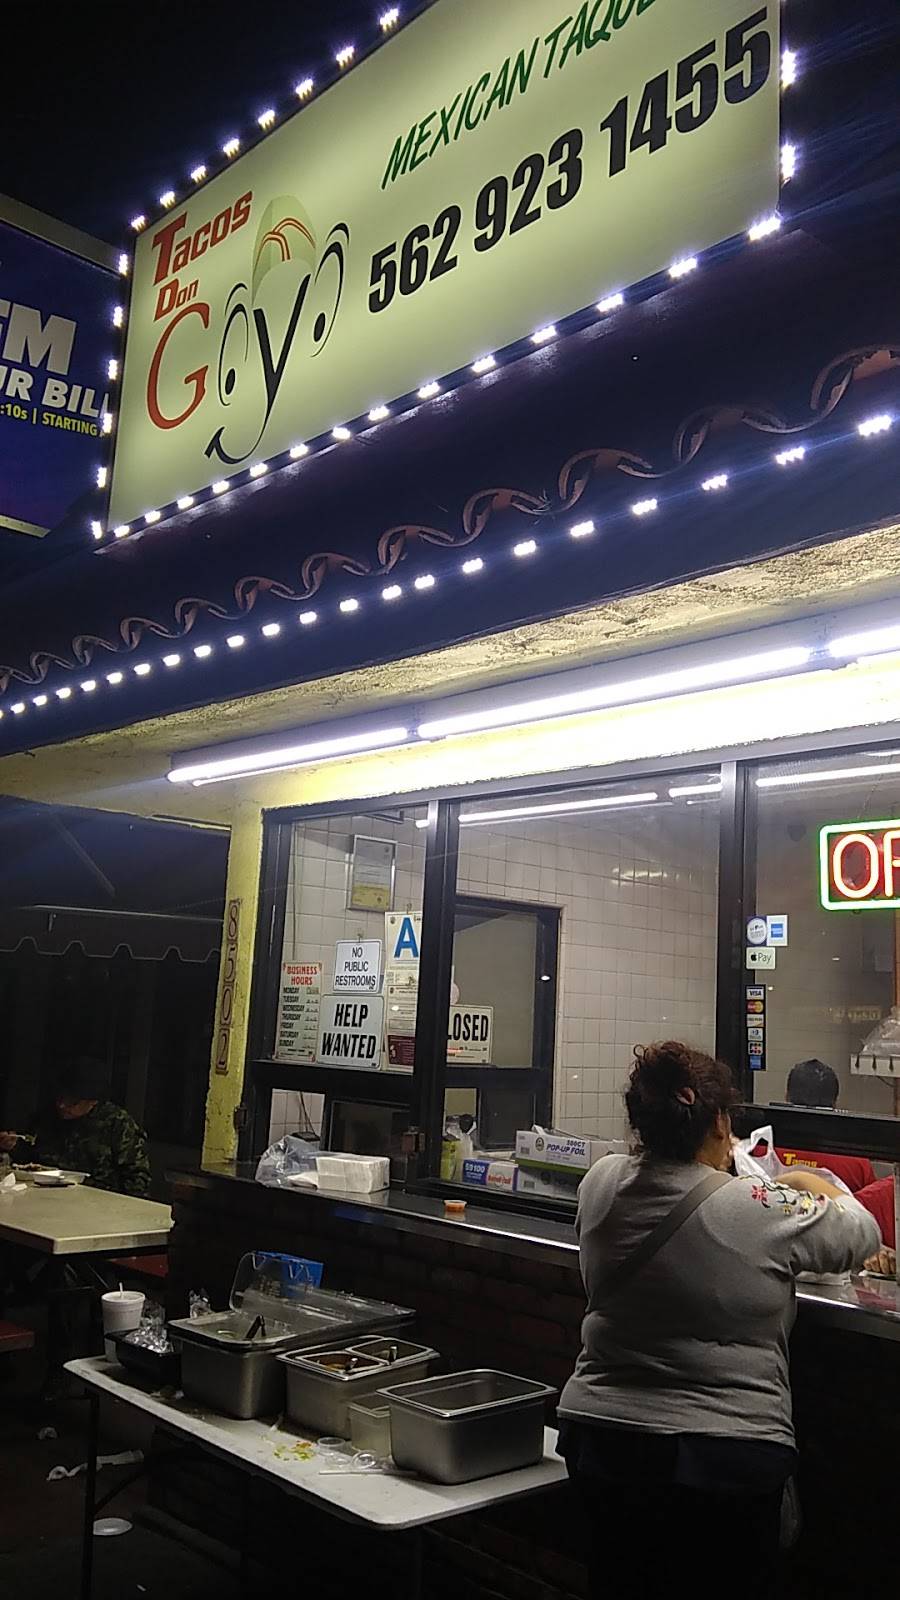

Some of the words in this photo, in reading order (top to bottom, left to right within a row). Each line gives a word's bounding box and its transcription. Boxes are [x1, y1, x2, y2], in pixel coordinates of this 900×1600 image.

[381, 36, 540, 190] MEXICAN
[368, 205, 461, 314] 562
[473, 128, 584, 253] 923
[600, 6, 771, 178] 1455
[42, 412, 98, 437] STARTING
[393, 917, 419, 959] A
[351, 947, 363, 958] NO
[758, 953, 771, 964] Pay
[287, 966, 317, 975] BUSINESS
[344, 961, 369, 972] PUBLIC
[291, 976, 313, 985] HOURS
[335, 975, 377, 986] RESTROOMS
[334, 1004, 369, 1028] HELP
[321, 1032, 377, 1059] WANTED
